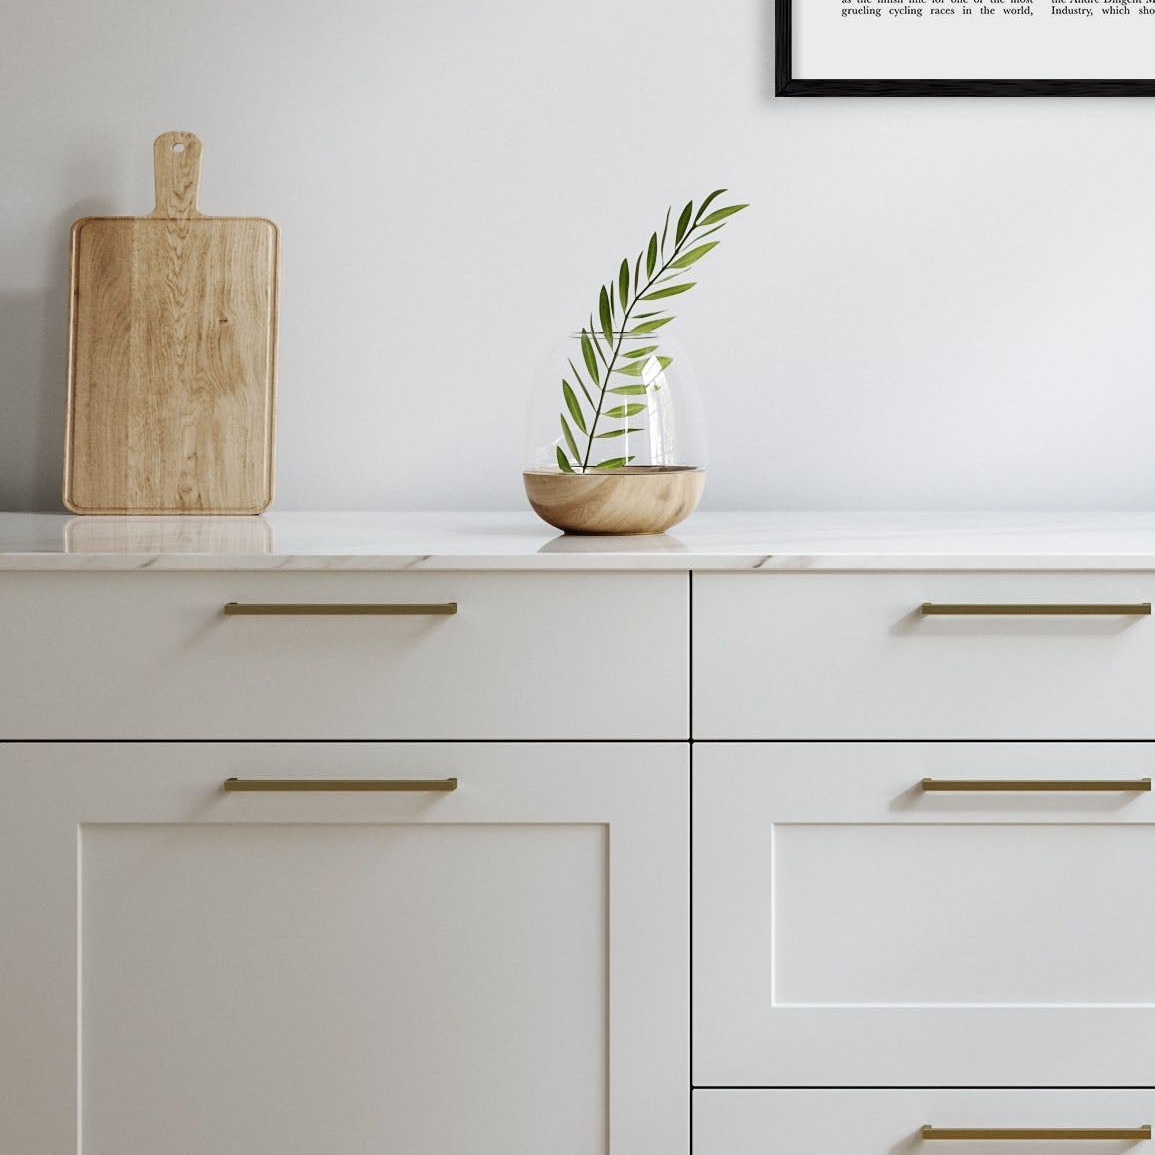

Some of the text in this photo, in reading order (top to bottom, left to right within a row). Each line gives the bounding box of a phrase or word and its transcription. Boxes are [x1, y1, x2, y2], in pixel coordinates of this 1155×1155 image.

[841, 6, 881, 17] grueling
[888, 6, 922, 17] cycling
[962, 6, 972, 14] in
[980, 6, 995, 14] the
[1003, 6, 1033, 16] world,
[1051, 6, 1093, 17] Industry,
[1101, 6, 1130, 14] which
